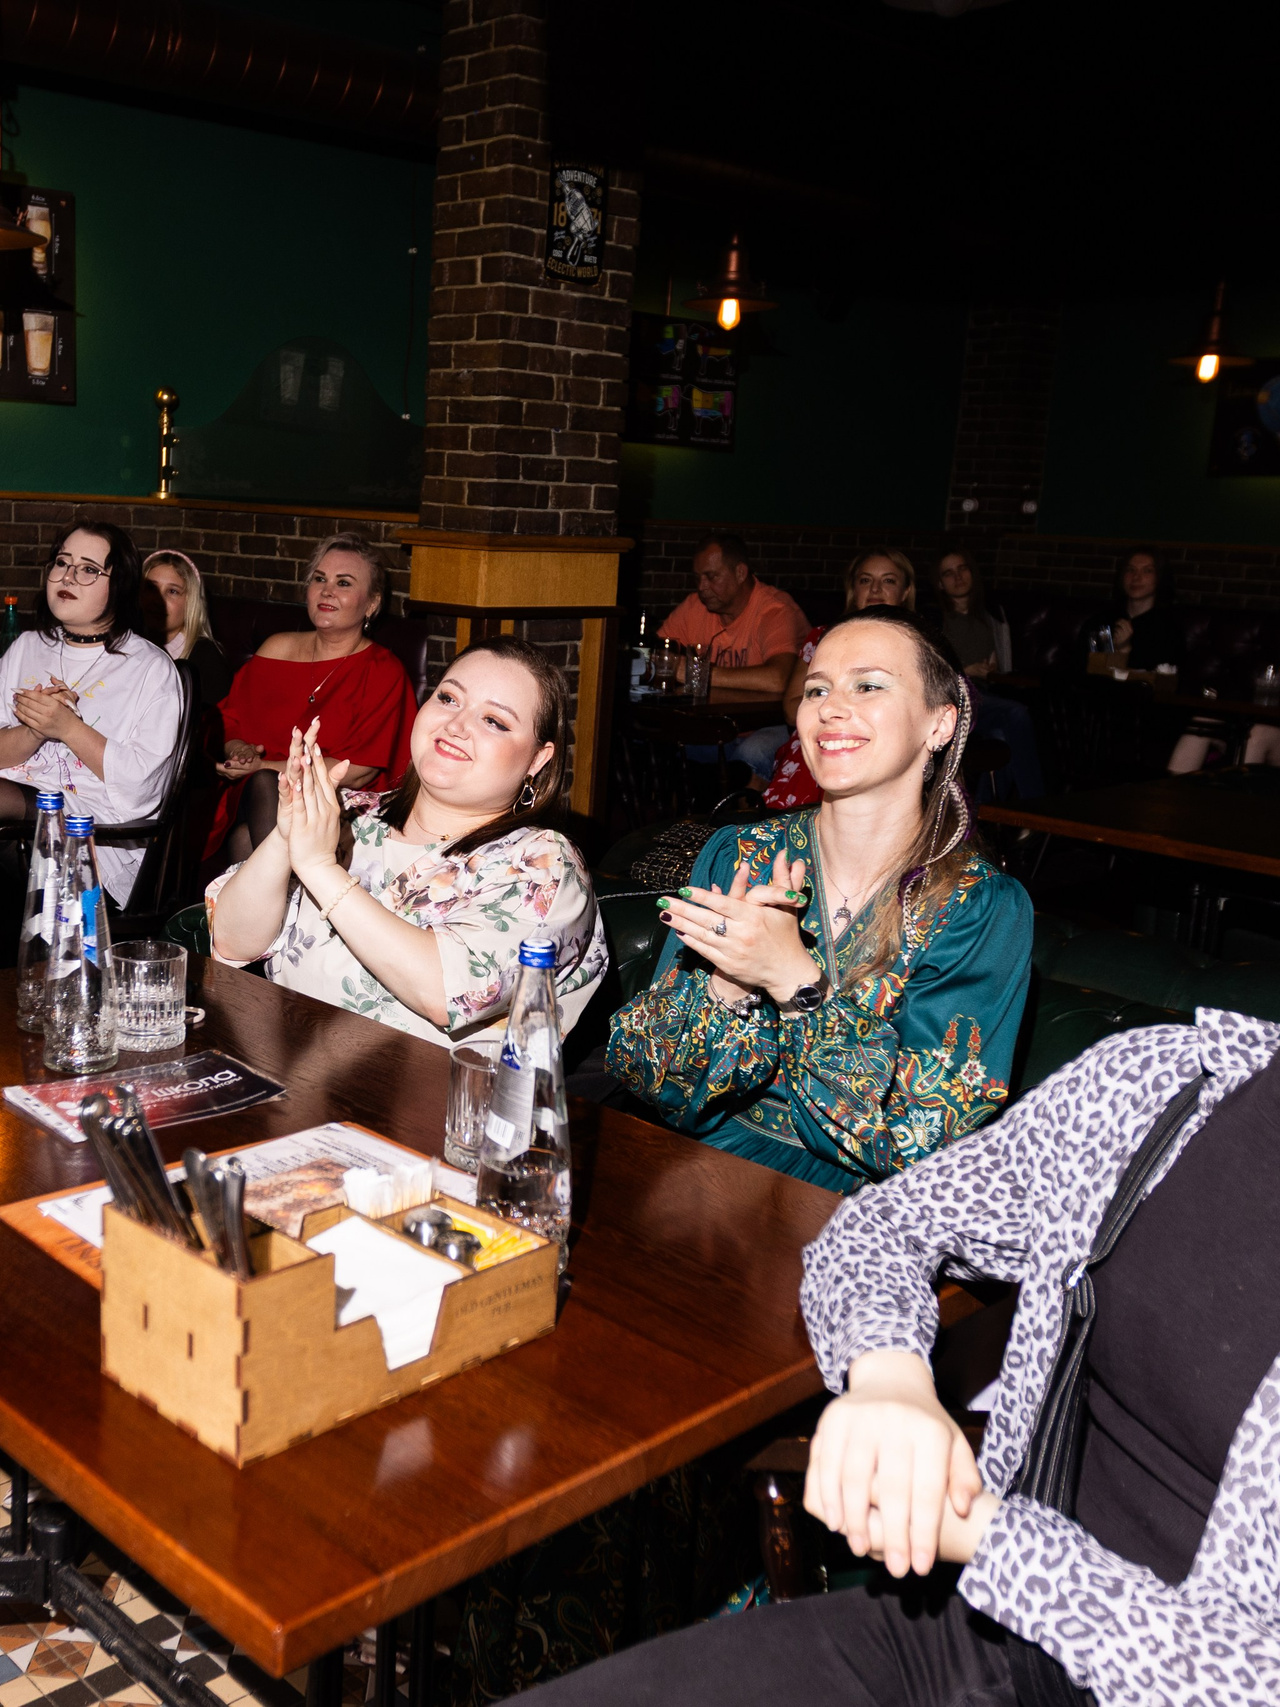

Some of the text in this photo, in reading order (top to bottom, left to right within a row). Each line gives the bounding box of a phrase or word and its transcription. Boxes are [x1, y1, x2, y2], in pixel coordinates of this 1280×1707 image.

[562, 169, 598, 188] ADVENTURE
[552, 201, 567, 227] 18
[548, 257, 599, 278] ECLECTIC WORLD
[480, 1274, 543, 1305] GENTLEMAN
